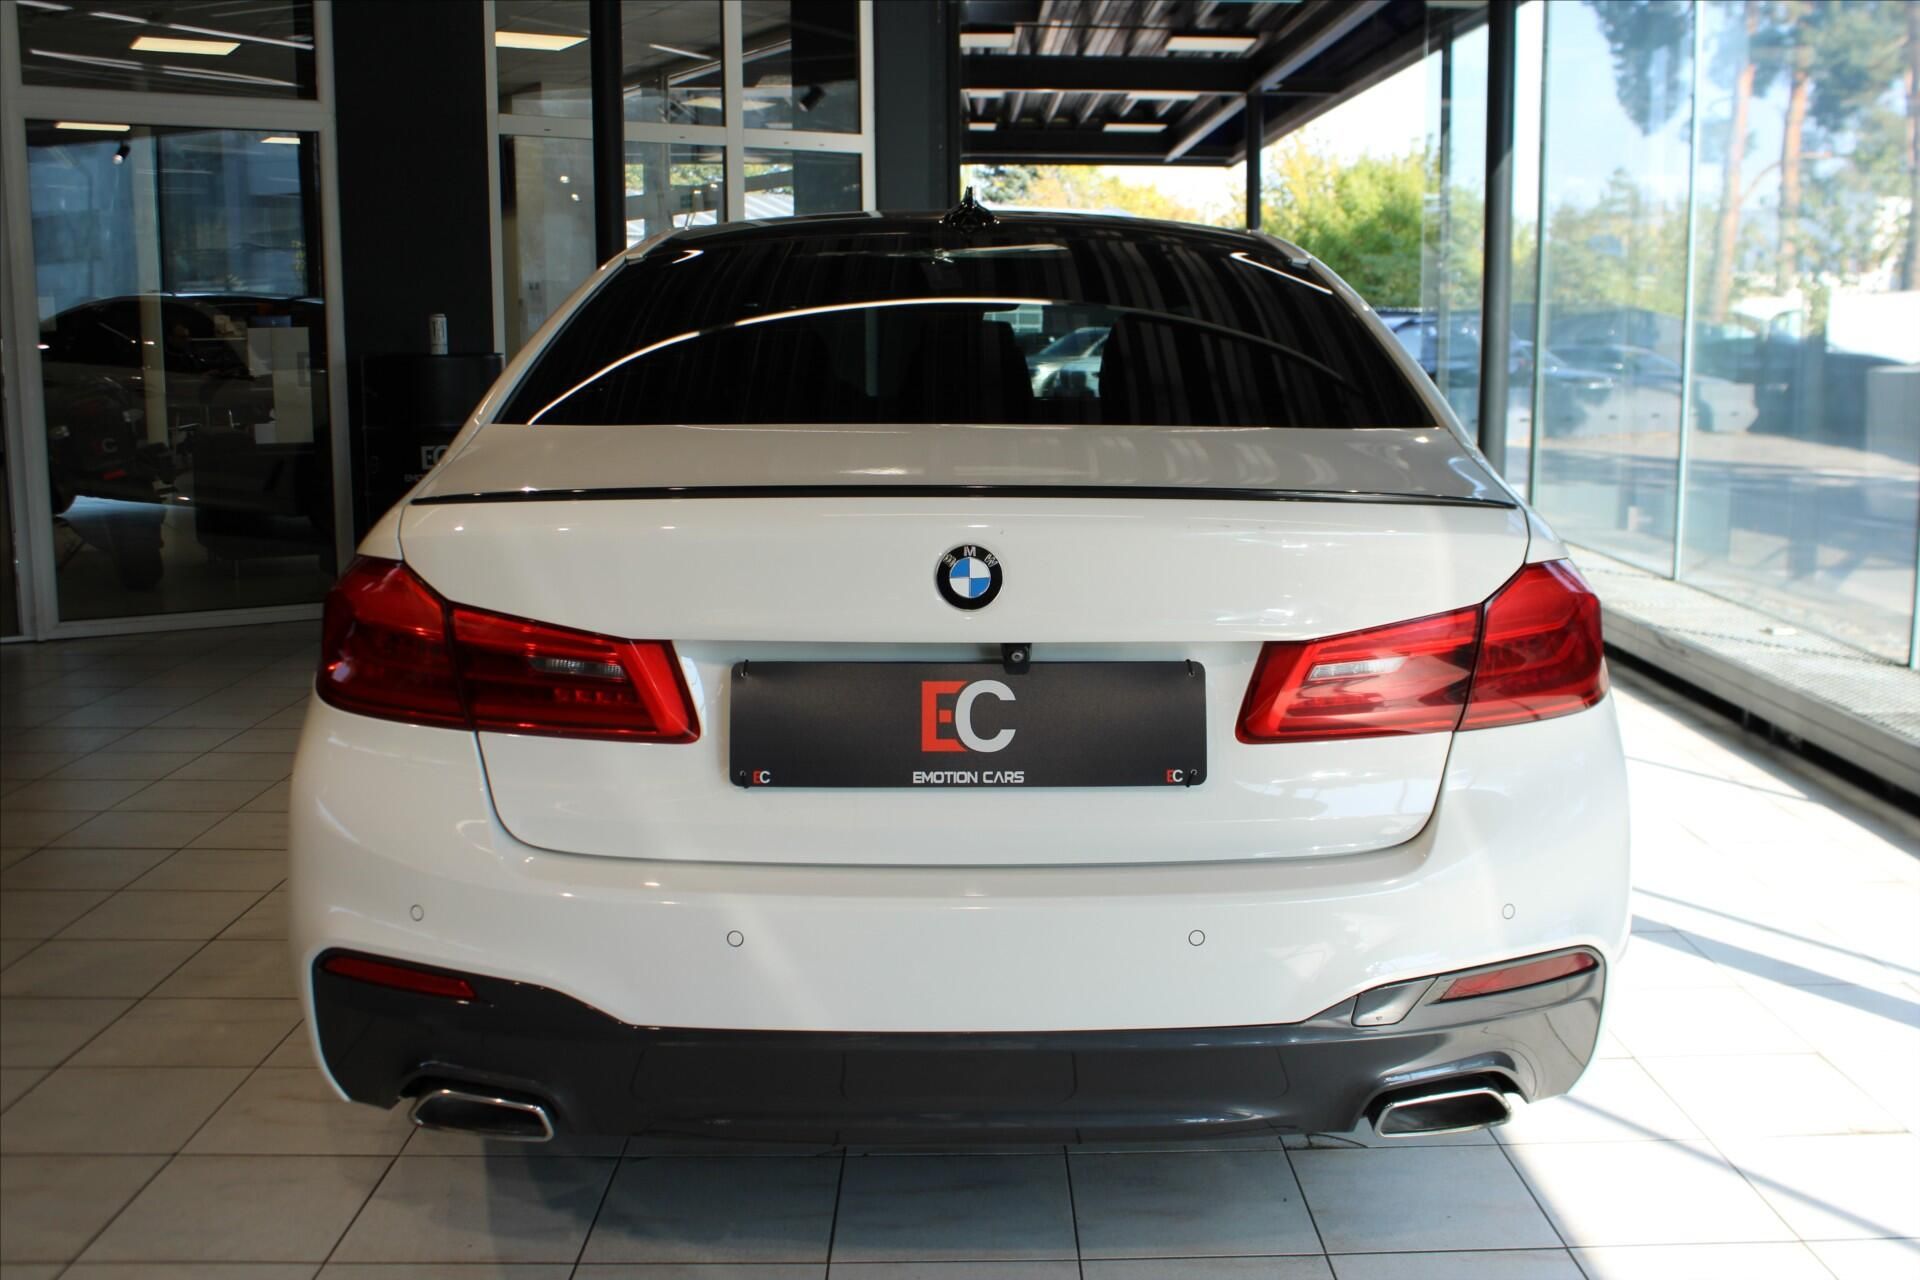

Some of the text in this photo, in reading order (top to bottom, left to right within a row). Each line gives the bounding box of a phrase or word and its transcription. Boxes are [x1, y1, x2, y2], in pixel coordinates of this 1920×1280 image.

[942, 546, 998, 568] BMW
[920, 680, 1017, 752] EC
[752, 769, 771, 784] EC
[912, 771, 1025, 784] EMOTION CARS
[1166, 769, 1184, 783] EC
